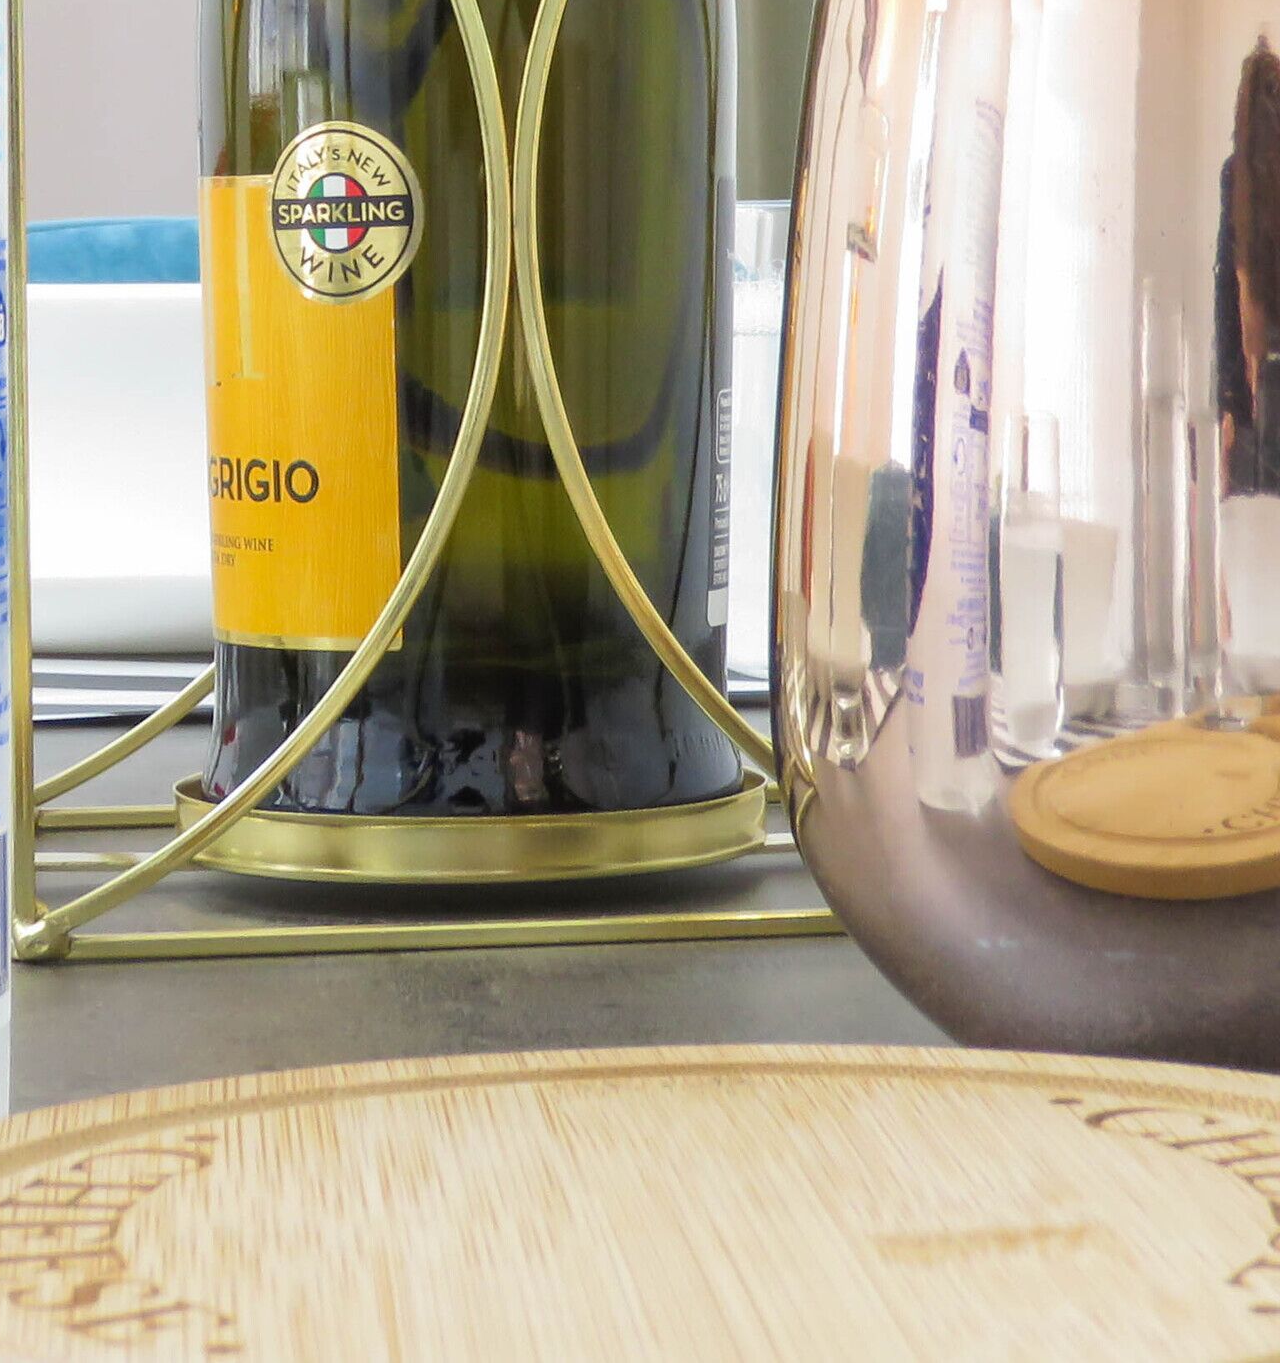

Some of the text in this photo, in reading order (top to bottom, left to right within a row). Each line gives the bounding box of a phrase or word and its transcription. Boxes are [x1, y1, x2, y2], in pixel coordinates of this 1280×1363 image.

[286, 146, 391, 193] ITALY'S NEW
[277, 201, 405, 226] SPARKLING
[299, 244, 385, 284] WINE
[209, 456, 320, 504] GRIGIO
[243, 537, 274, 552] WINE
